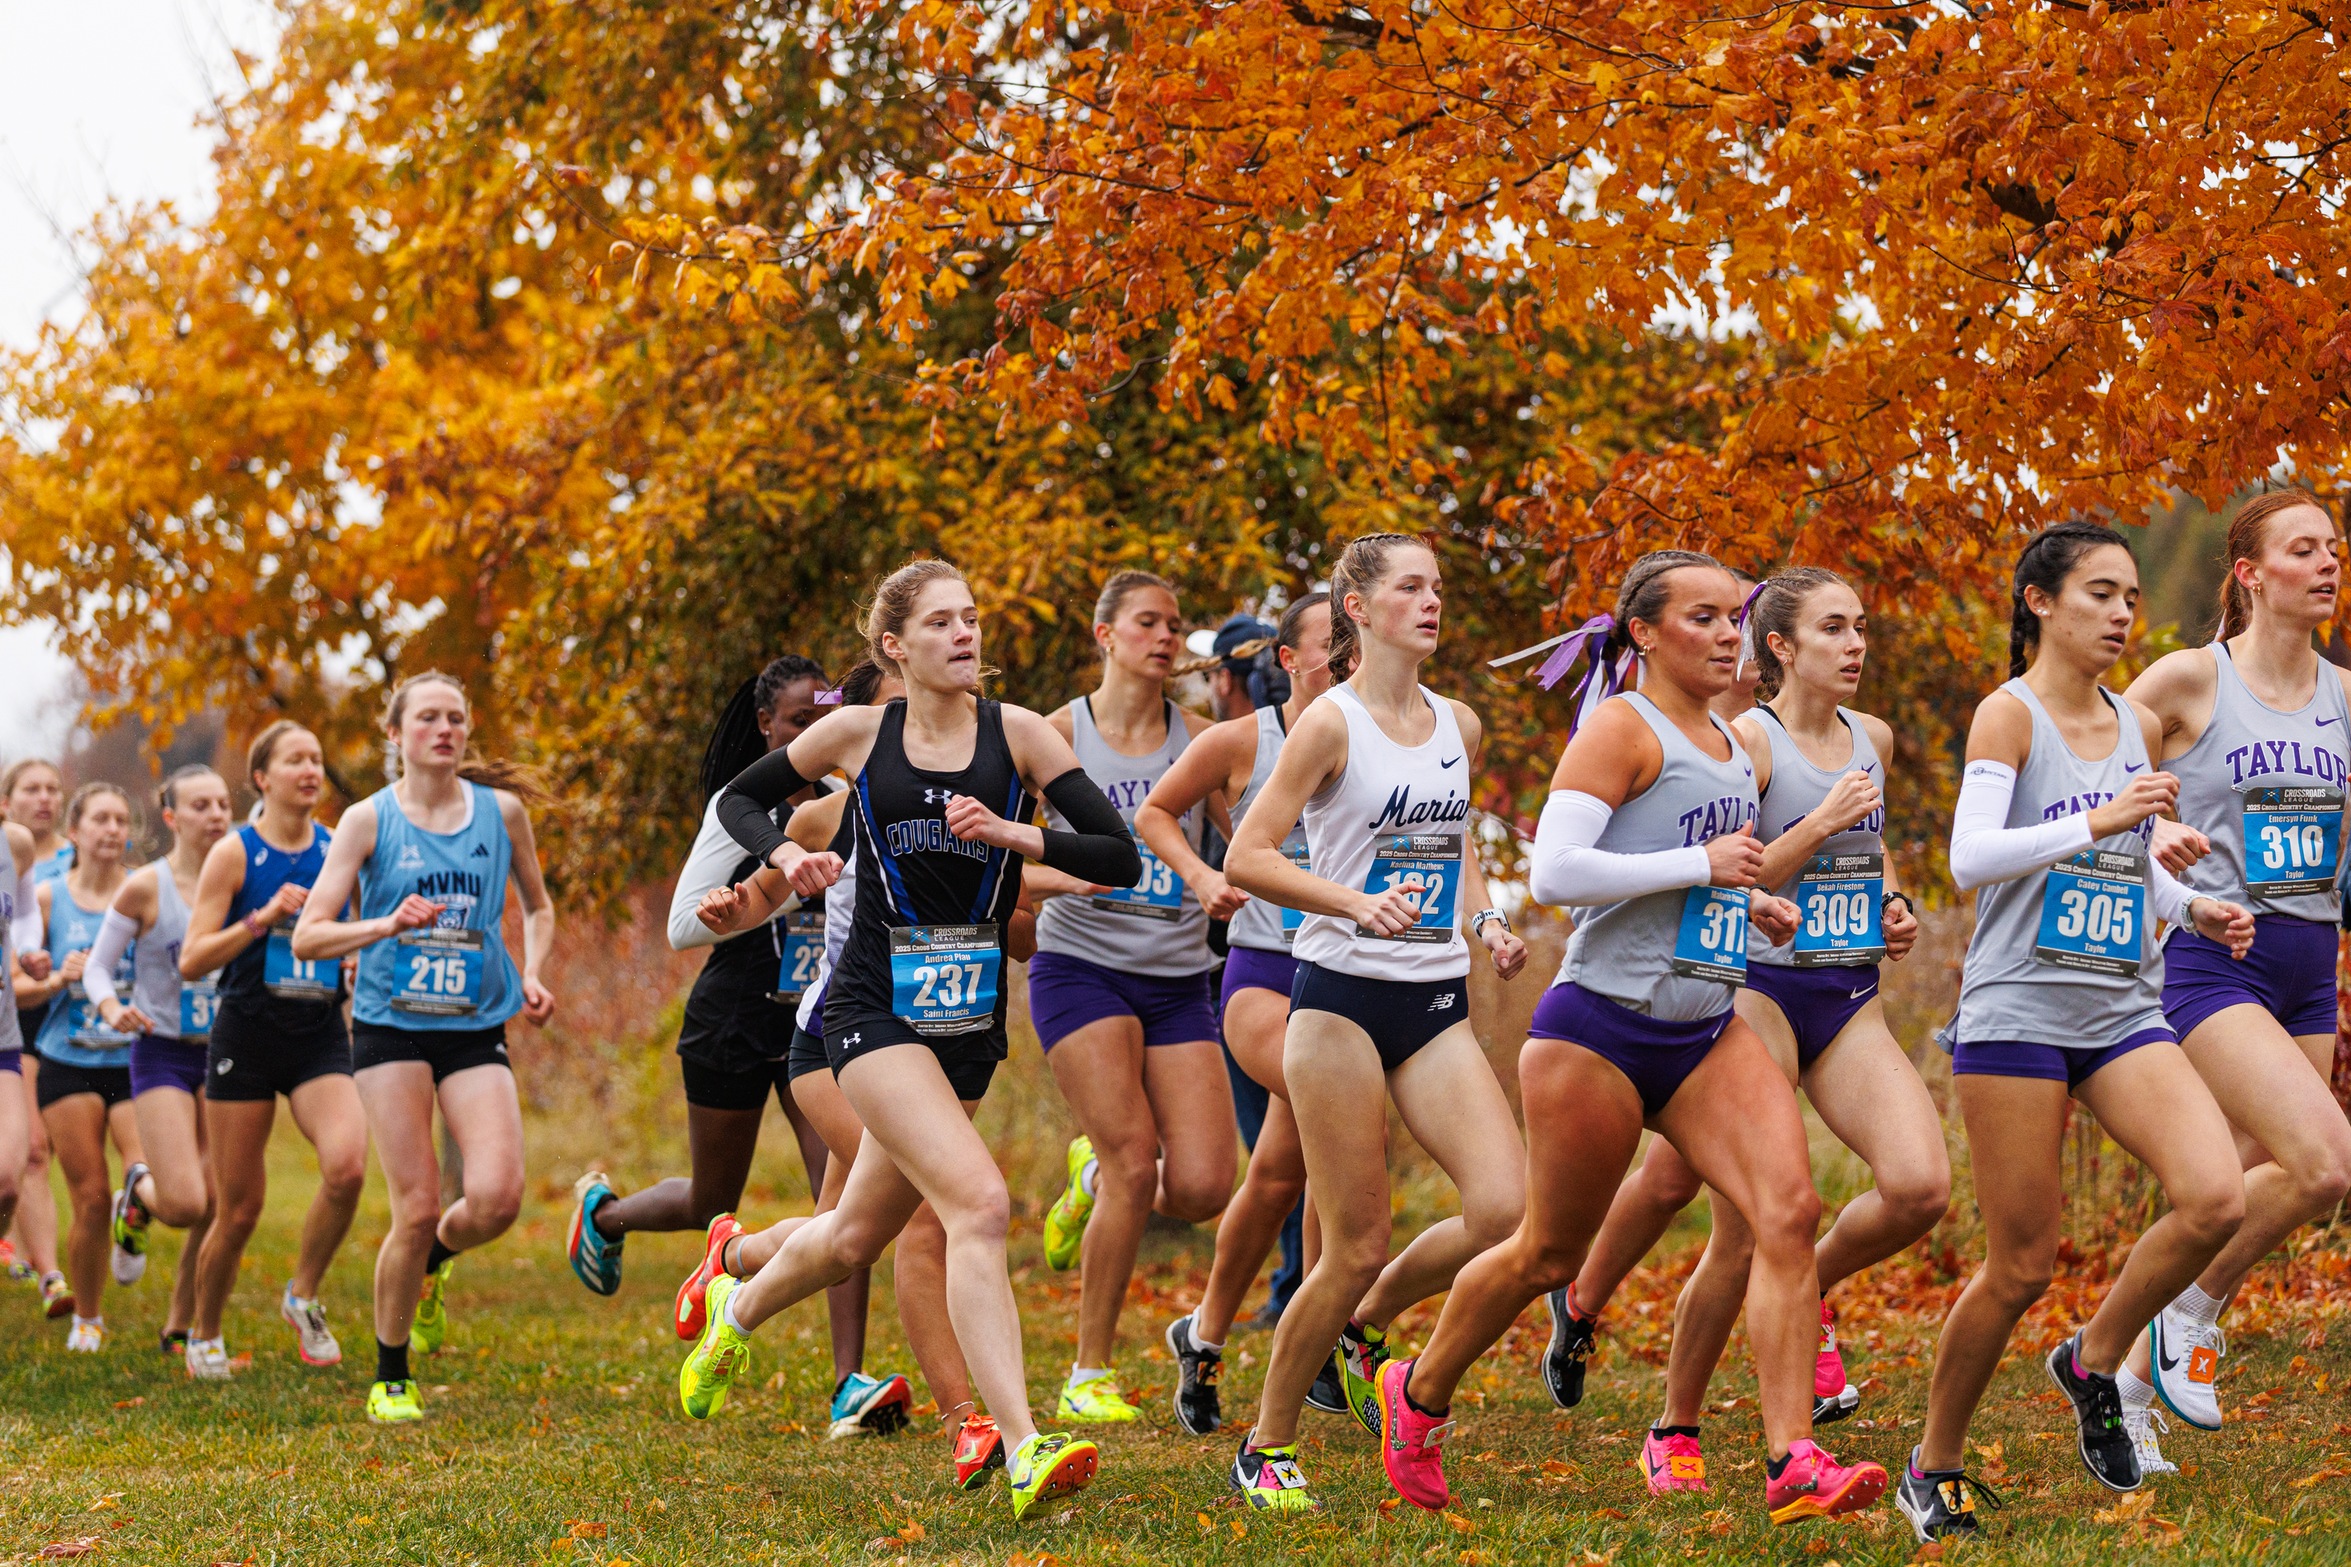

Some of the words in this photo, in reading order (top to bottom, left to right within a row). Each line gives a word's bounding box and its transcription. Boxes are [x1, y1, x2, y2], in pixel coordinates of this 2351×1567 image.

[2224, 739, 2348, 797] TAYLOR
[2284, 788, 2326, 798] CROSSROADS
[2268, 814, 2298, 823] Emersyn
[2299, 814, 2318, 823] Funk
[2260, 825, 2324, 869] 310
[2054, 862, 2073, 872] 2025
[2098, 862, 2124, 871] LEAGUE
[2285, 870, 2305, 879] Taylor
[417, 870, 482, 898] MVNU
[1836, 883, 1866, 891] Firestone
[1806, 892, 1870, 938] 309
[2057, 889, 2134, 945] 305
[933, 927, 978, 937] CROSSROADS
[1830, 939, 1849, 947] Taylor
[2084, 942, 2107, 954] Taylor
[894, 945, 912, 953] 2025
[925, 955, 954, 964] Andrea
[408, 954, 467, 995] 215
[913, 963, 983, 1007] 237
[923, 1009, 943, 1018] Saint
[944, 1007, 970, 1017] Francis
